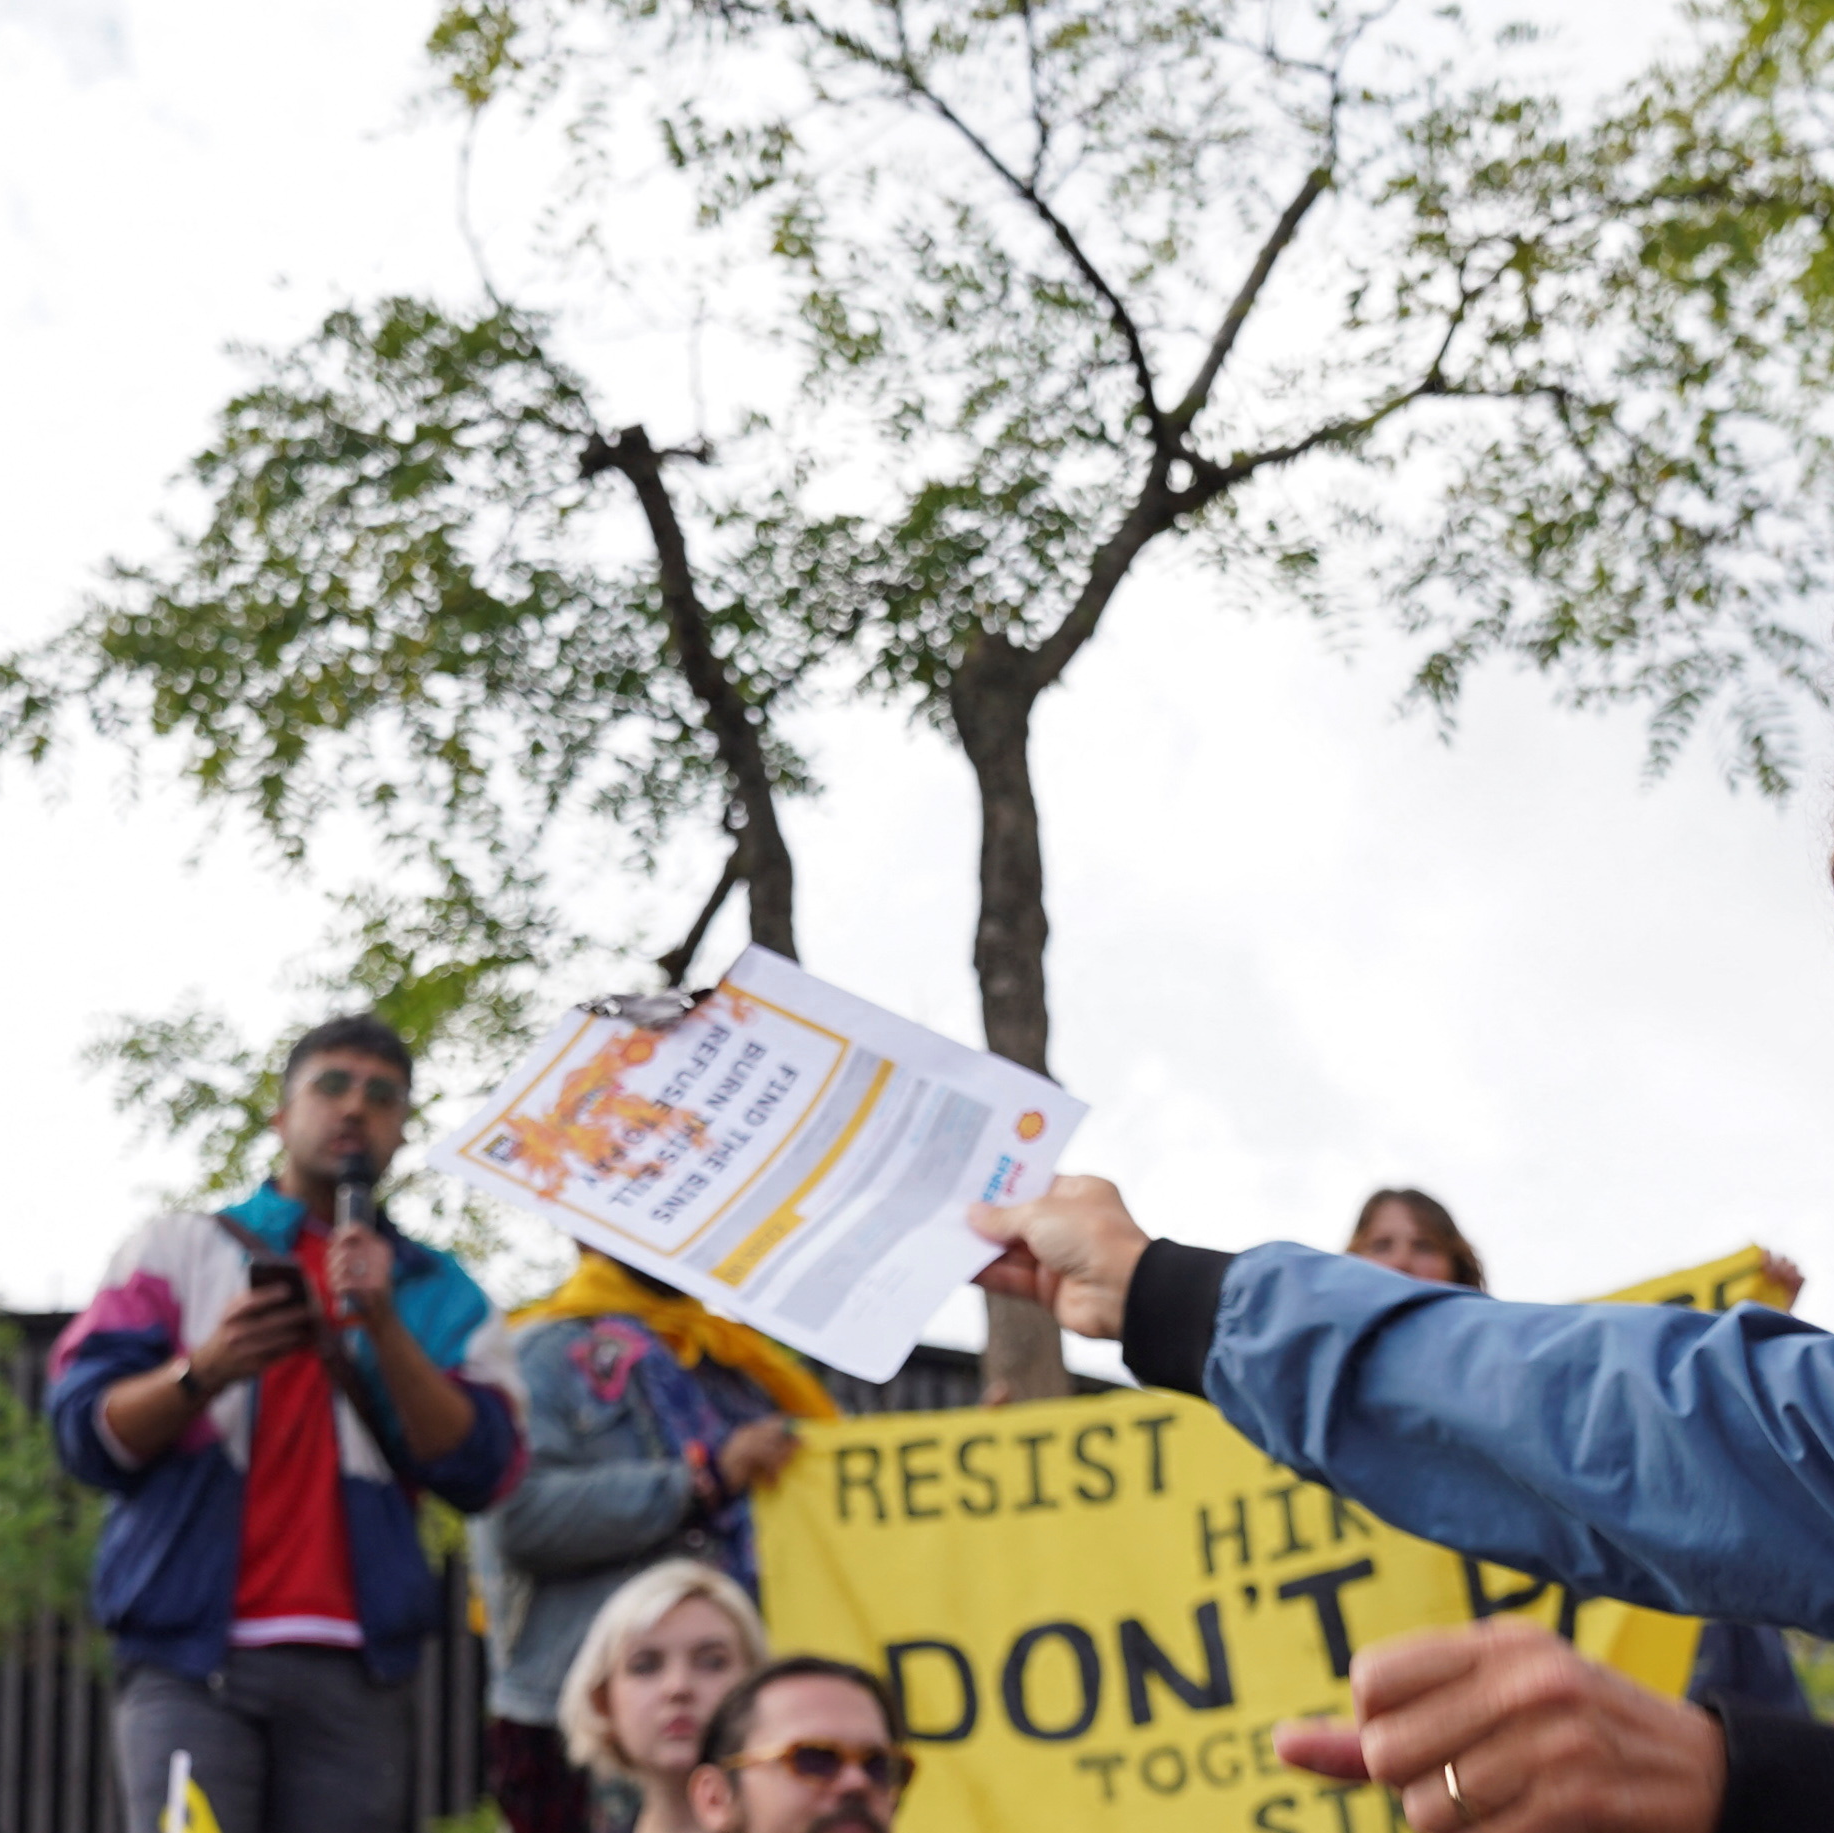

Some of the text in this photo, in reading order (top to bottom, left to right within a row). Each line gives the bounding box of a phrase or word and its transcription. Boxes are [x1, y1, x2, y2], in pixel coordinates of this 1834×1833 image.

[650, 1024, 731, 1115] REFUSE
[706, 1040, 767, 1111] BURN
[744, 1062, 799, 1128] FIND
[704, 1129, 753, 1174] THE
[650, 1172, 710, 1225] BINS
[833, 1414, 1178, 1525] RESIST
[885, 1558, 1375, 1744] DON'T
